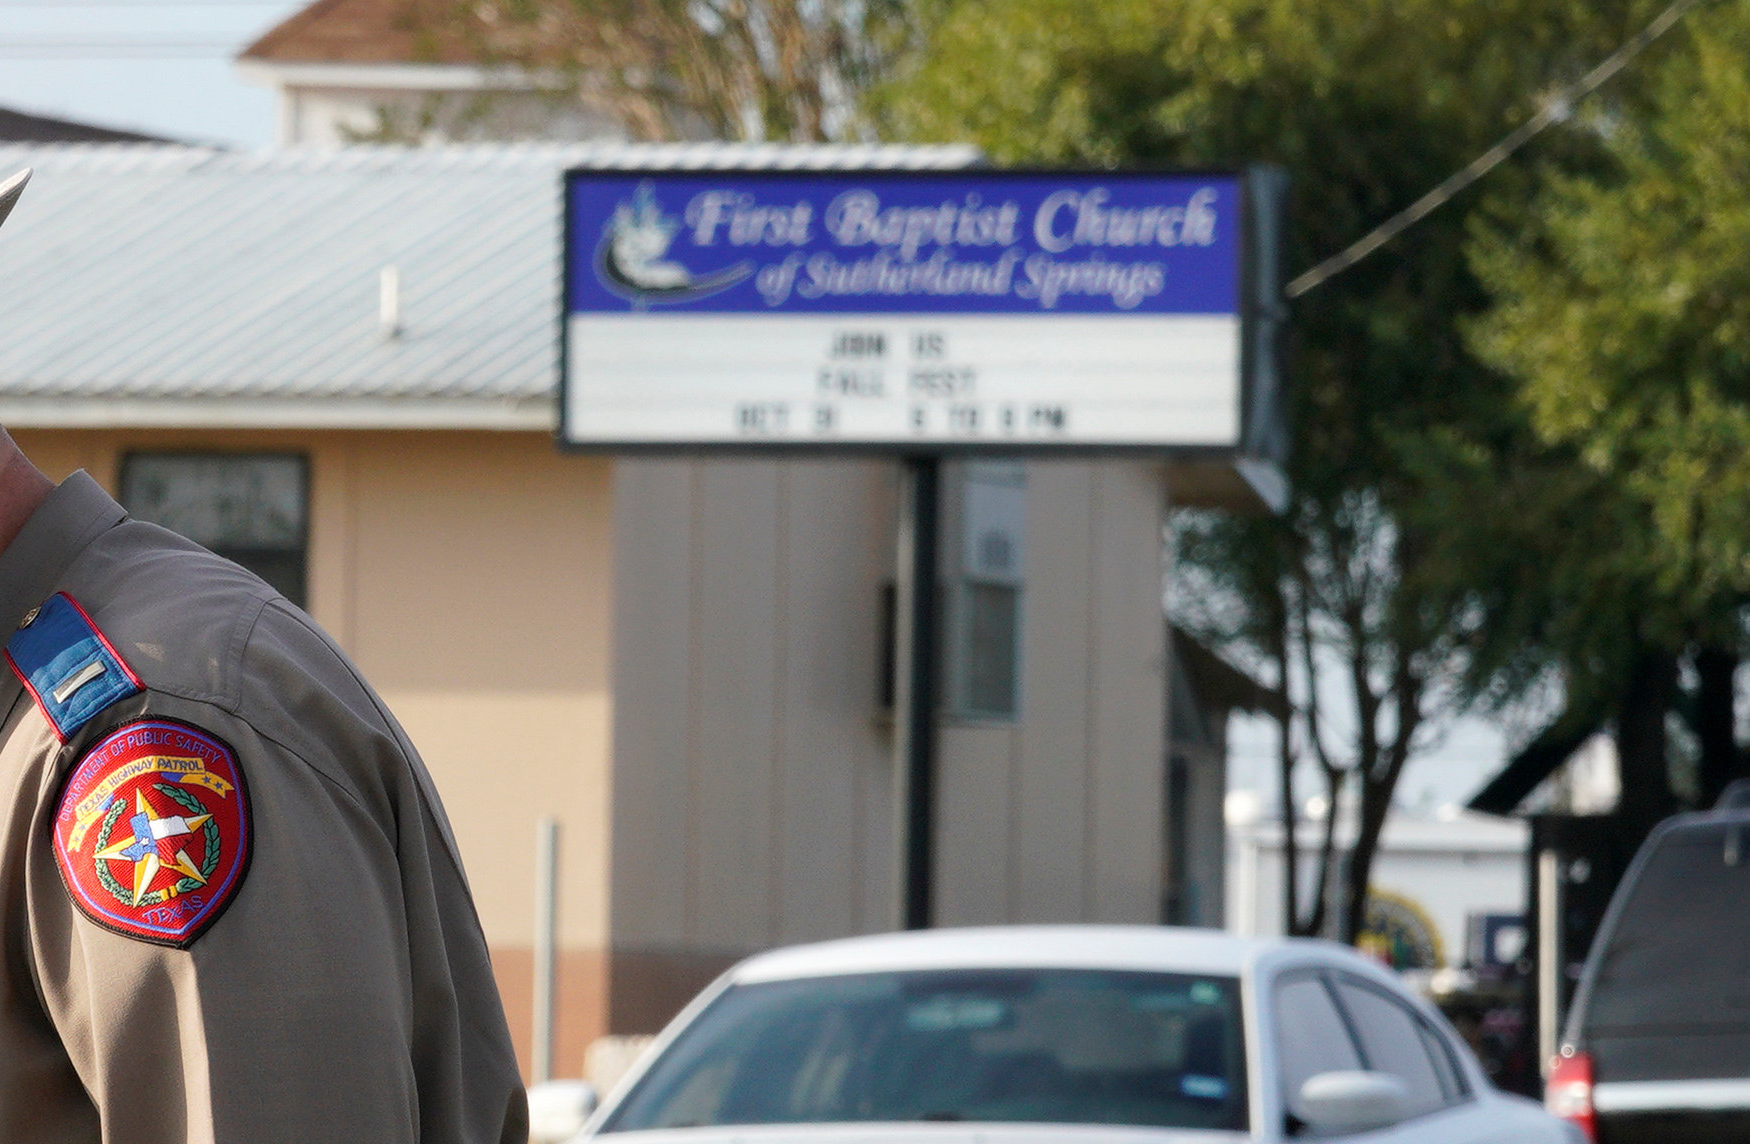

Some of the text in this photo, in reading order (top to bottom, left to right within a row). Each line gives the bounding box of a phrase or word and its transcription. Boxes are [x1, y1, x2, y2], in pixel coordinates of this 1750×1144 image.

[684, 186, 1218, 263] First Baptist Church
[755, 249, 1166, 310] of Sutherland Springs
[832, 331, 945, 358] JOIN US
[817, 366, 977, 396] FALL FEST
[736, 403, 788, 431] OCT
[949, 403, 981, 431] TO
[1027, 403, 1068, 431] PM
[61, 731, 222, 821] DEPARTMENT OF PUBLIC SAFETY
[79, 758, 203, 815] TEXAS HIGHWAY PATROL
[142, 895, 204, 923] TEXAS
